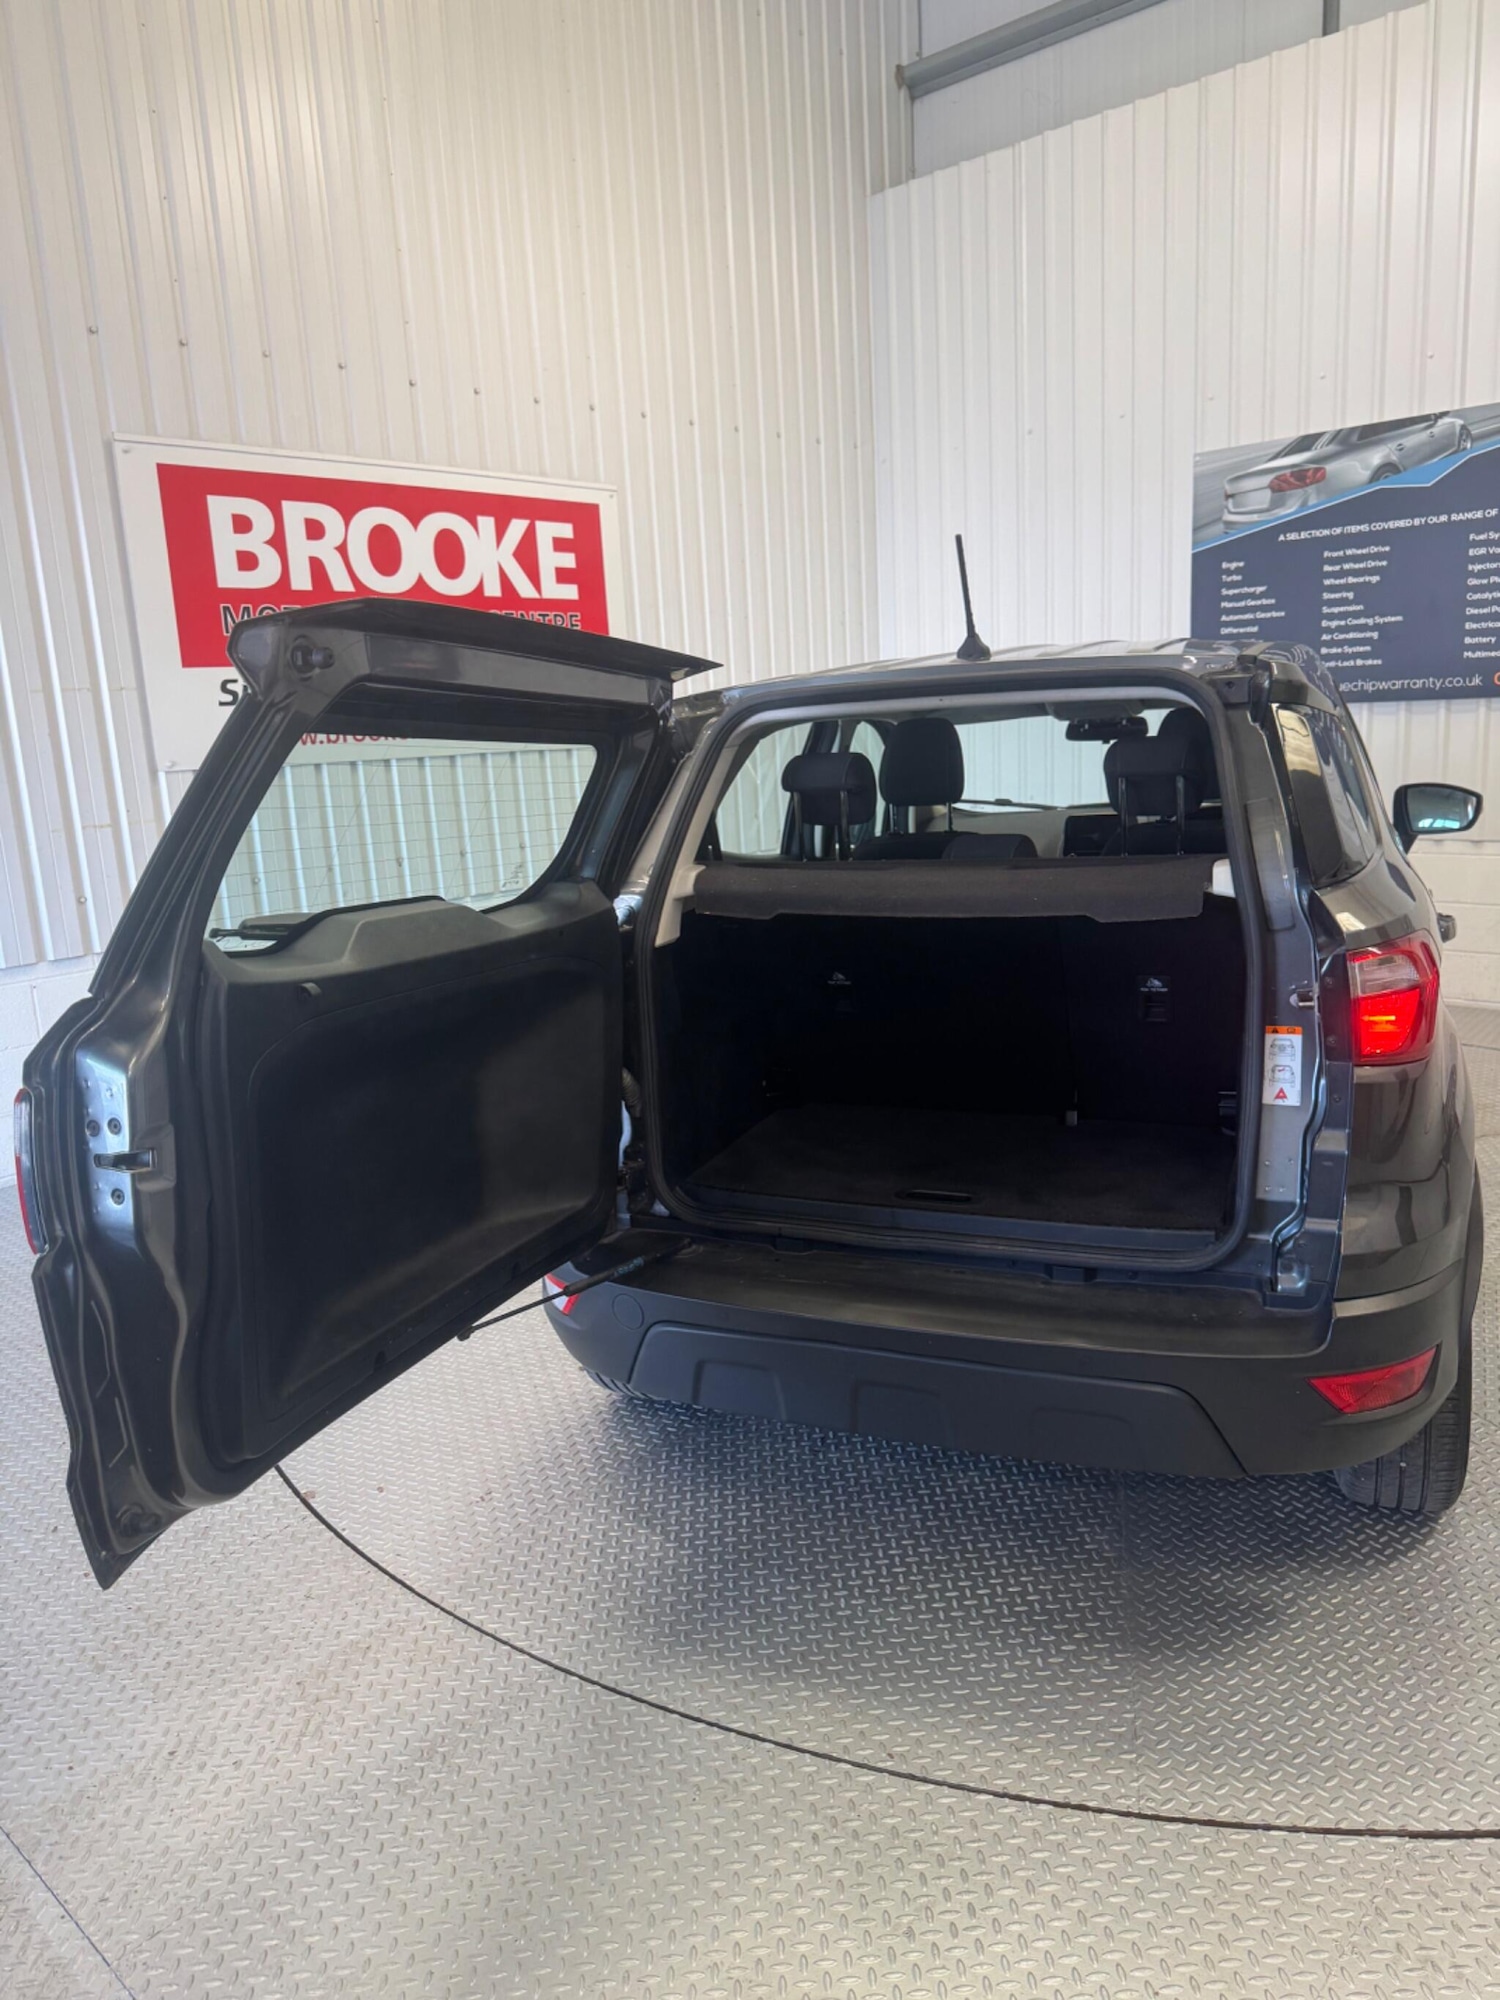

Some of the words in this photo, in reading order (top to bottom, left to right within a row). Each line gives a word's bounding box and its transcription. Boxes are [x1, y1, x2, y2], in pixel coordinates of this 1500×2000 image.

[1286, 529, 1330, 540] SELECTION
[1332, 527, 1343, 535] OF
[1344, 524, 1369, 534] ITEMS
[1371, 519, 1412, 531] COVERED
[1414, 517, 1425, 525] BY
[1427, 515, 1448, 523] OUR
[1451, 511, 1484, 521] RANGE
[1485, 509, 1499, 517] OF
[1469, 532, 1487, 541] Fuel
[206, 494, 579, 600] BROOKE
[1469, 547, 1487, 556] EGR
[1324, 550, 1344, 558] Front
[1345, 547, 1368, 556] Wheel
[1222, 562, 1244, 570] Engine
[1343, 562, 1366, 570] Wheel
[1367, 560, 1388, 568] Drive
[1323, 577, 1346, 585] Wheel
[1348, 575, 1380, 583] Bearings
[1221, 586, 1267, 595] Supercharger
[1322, 591, 1354, 600] Steering
[1221, 600, 1245, 608] Manual
[1247, 598, 1276, 606] Gearbox
[1322, 604, 1364, 613] Suspension
[1466, 606, 1490, 615] Diesel
[1221, 613, 1254, 621] Automatic
[1256, 611, 1285, 619] Gearbox
[1322, 620, 1345, 628] Engine
[1347, 617, 1373, 626] Cooling
[1374, 615, 1403, 624] System
[1220, 626, 1258, 634] Differential
[1333, 631, 1378, 639] Conditioning
[1464, 636, 1496, 644] Battery
[1343, 645, 1371, 654] System
[1356, 658, 1382, 666] Brakes
